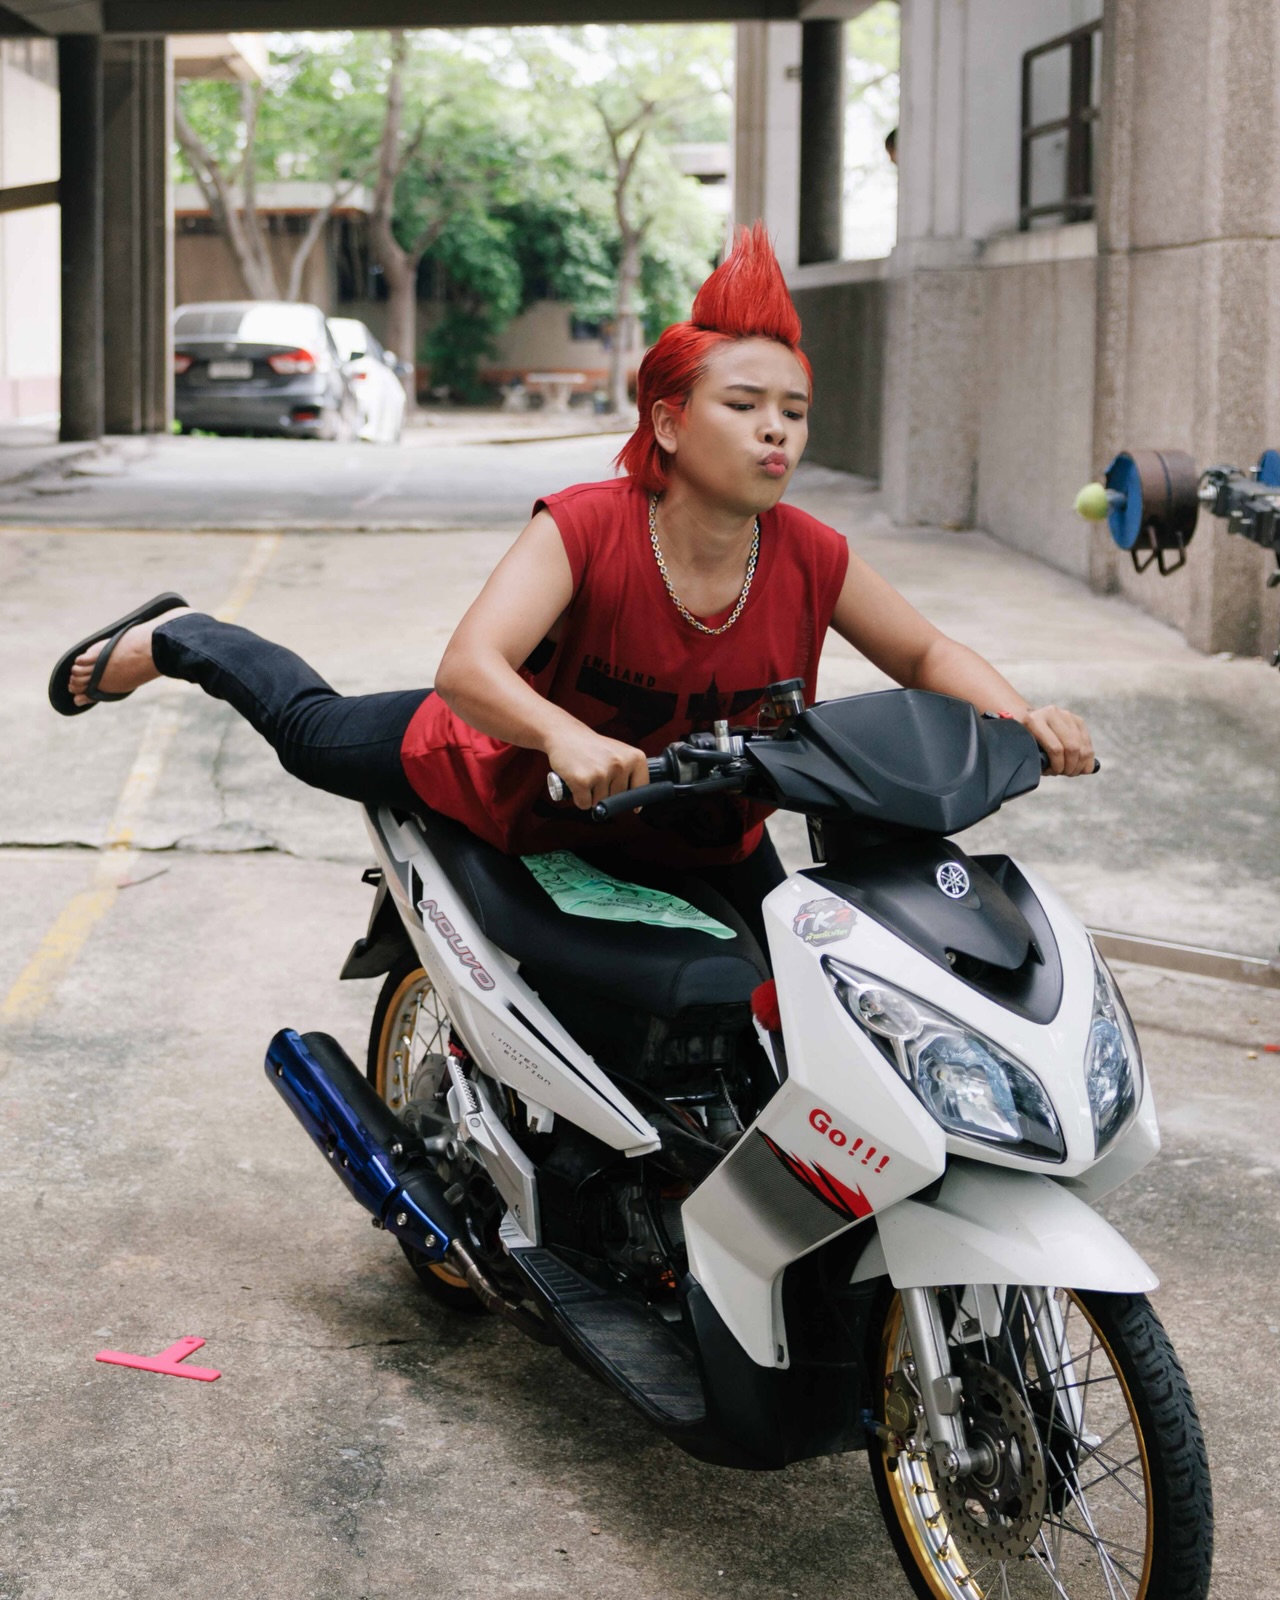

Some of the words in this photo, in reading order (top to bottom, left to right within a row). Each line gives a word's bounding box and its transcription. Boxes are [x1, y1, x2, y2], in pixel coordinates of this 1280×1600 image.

[583, 655, 656, 687] ENGLAND
[420, 900, 496, 991] NOUVO
[808, 1108, 890, 1174] Go!!!
